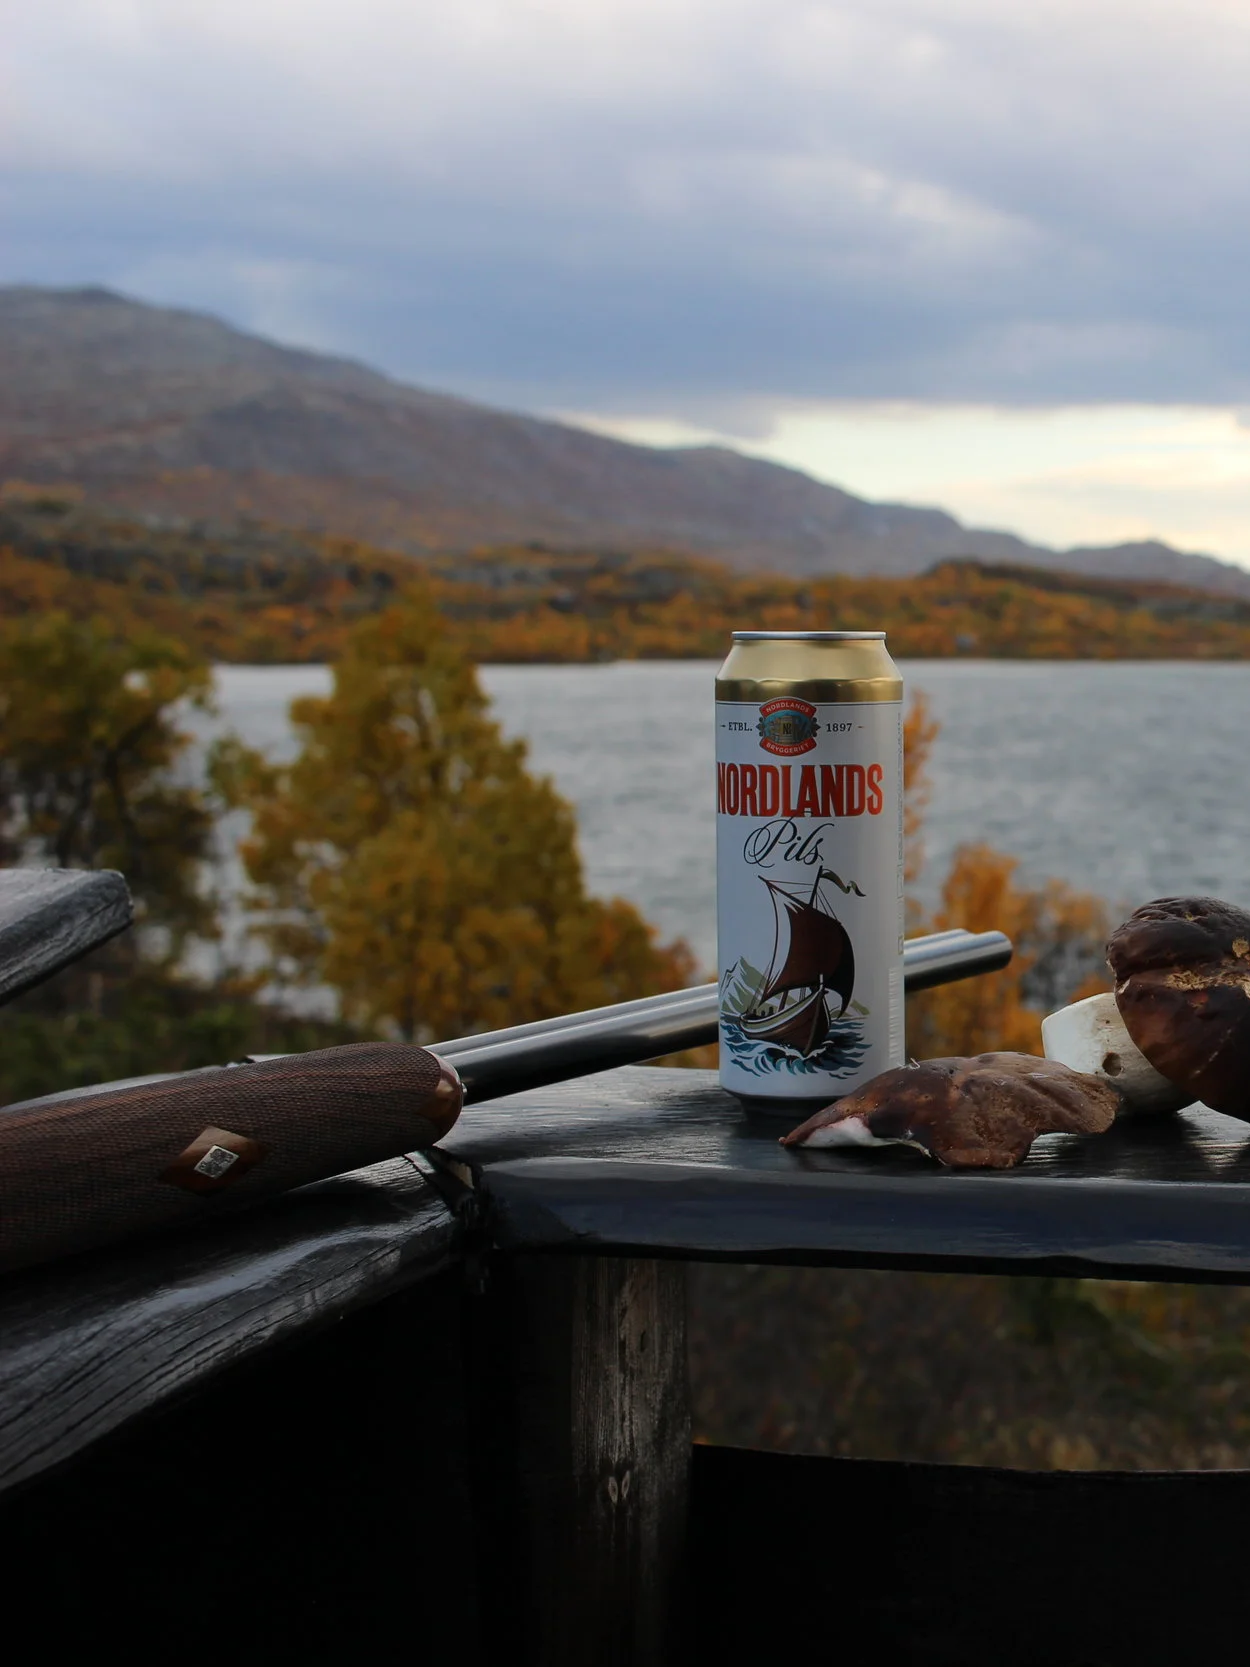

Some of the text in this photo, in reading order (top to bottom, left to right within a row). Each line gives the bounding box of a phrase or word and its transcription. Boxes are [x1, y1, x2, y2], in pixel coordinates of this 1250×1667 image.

[766, 702, 809, 713] NORDLANDS
[728, 722, 852, 732] ETBL. 1897
[766, 742, 809, 753] BRYGGERIET
[717, 762, 883, 817] NORDLANDS
[743, 817, 835, 868] Pils
